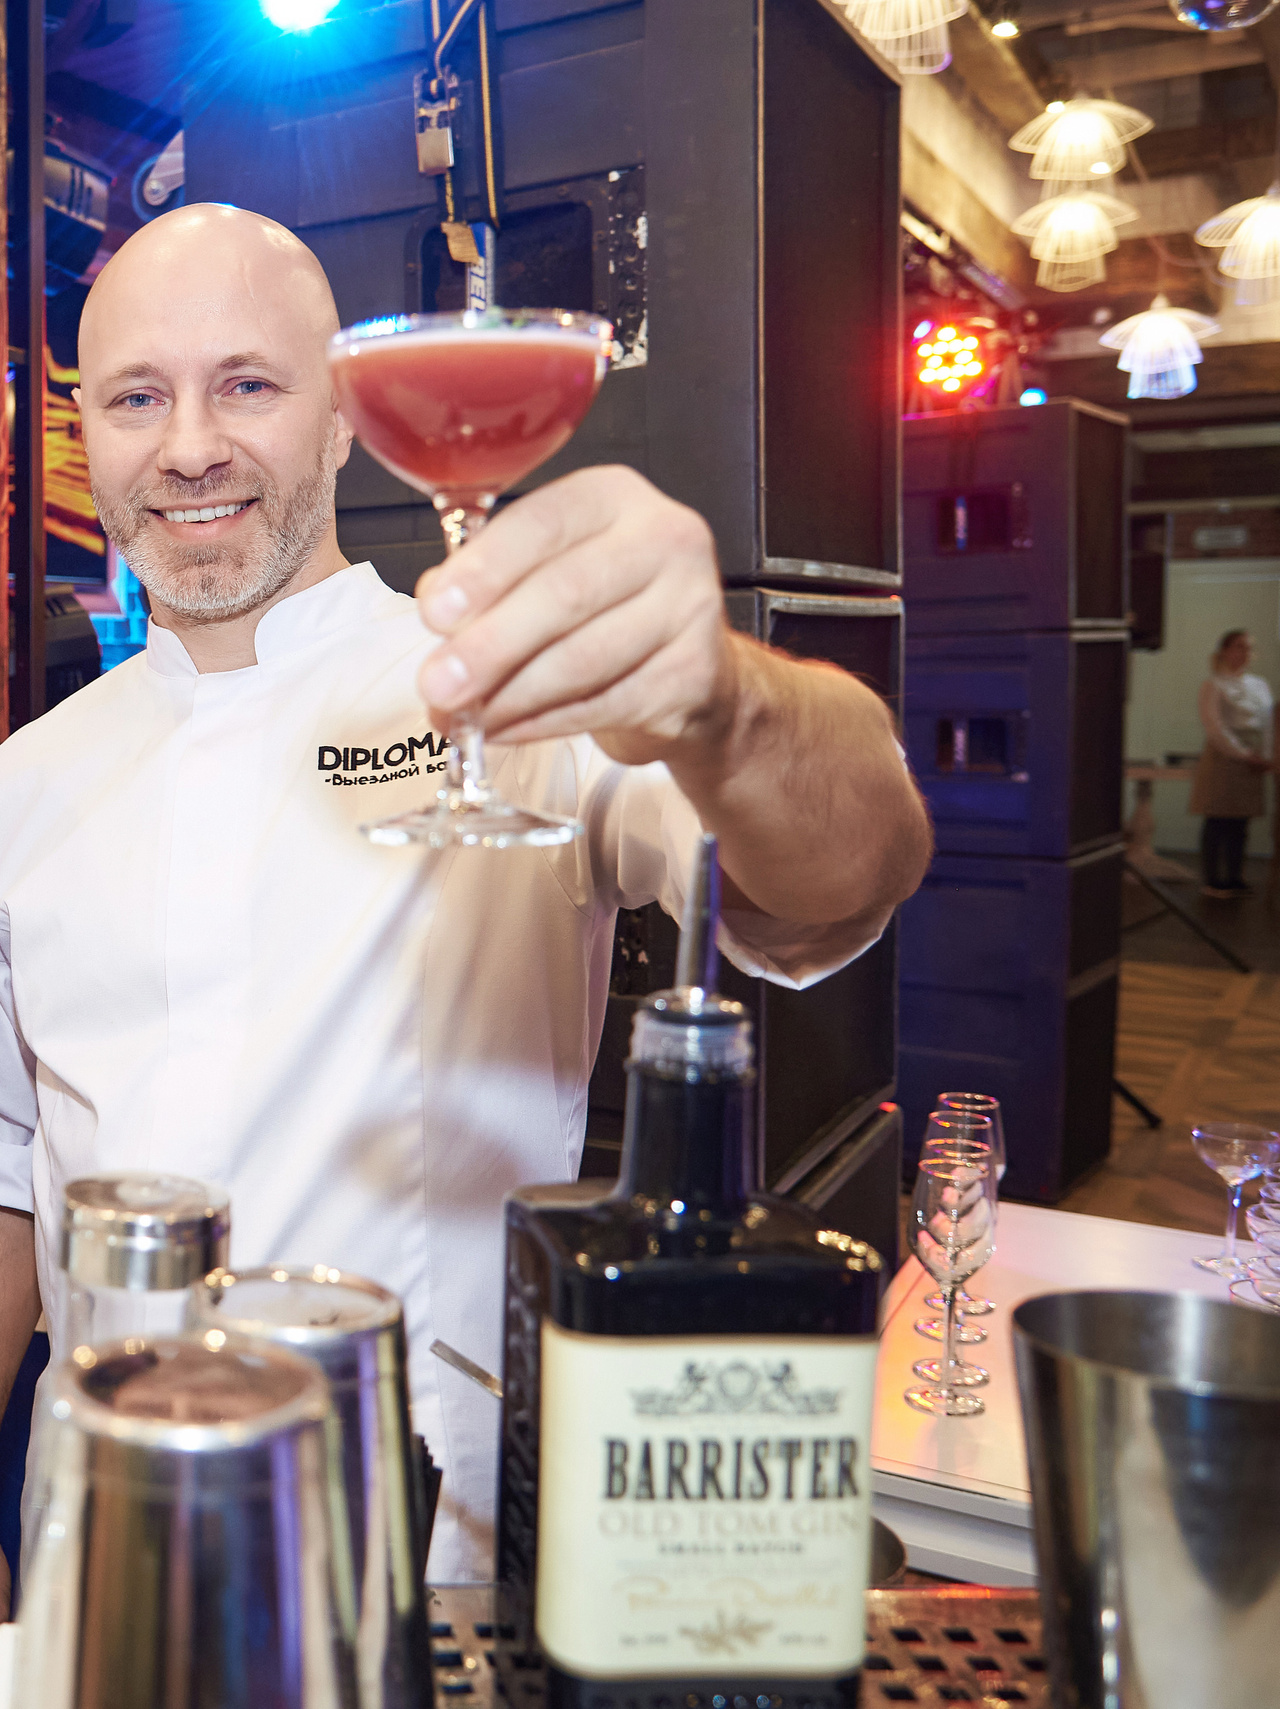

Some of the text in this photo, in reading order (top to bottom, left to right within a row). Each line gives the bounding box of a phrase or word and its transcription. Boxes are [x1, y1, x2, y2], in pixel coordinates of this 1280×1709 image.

[318, 731, 452, 771] DIPLOMA
[426, 761, 448, 774] ба
[603, 1436, 860, 1501] BARRISTER
[598, 1508, 864, 1540] OLD TOM GIN
